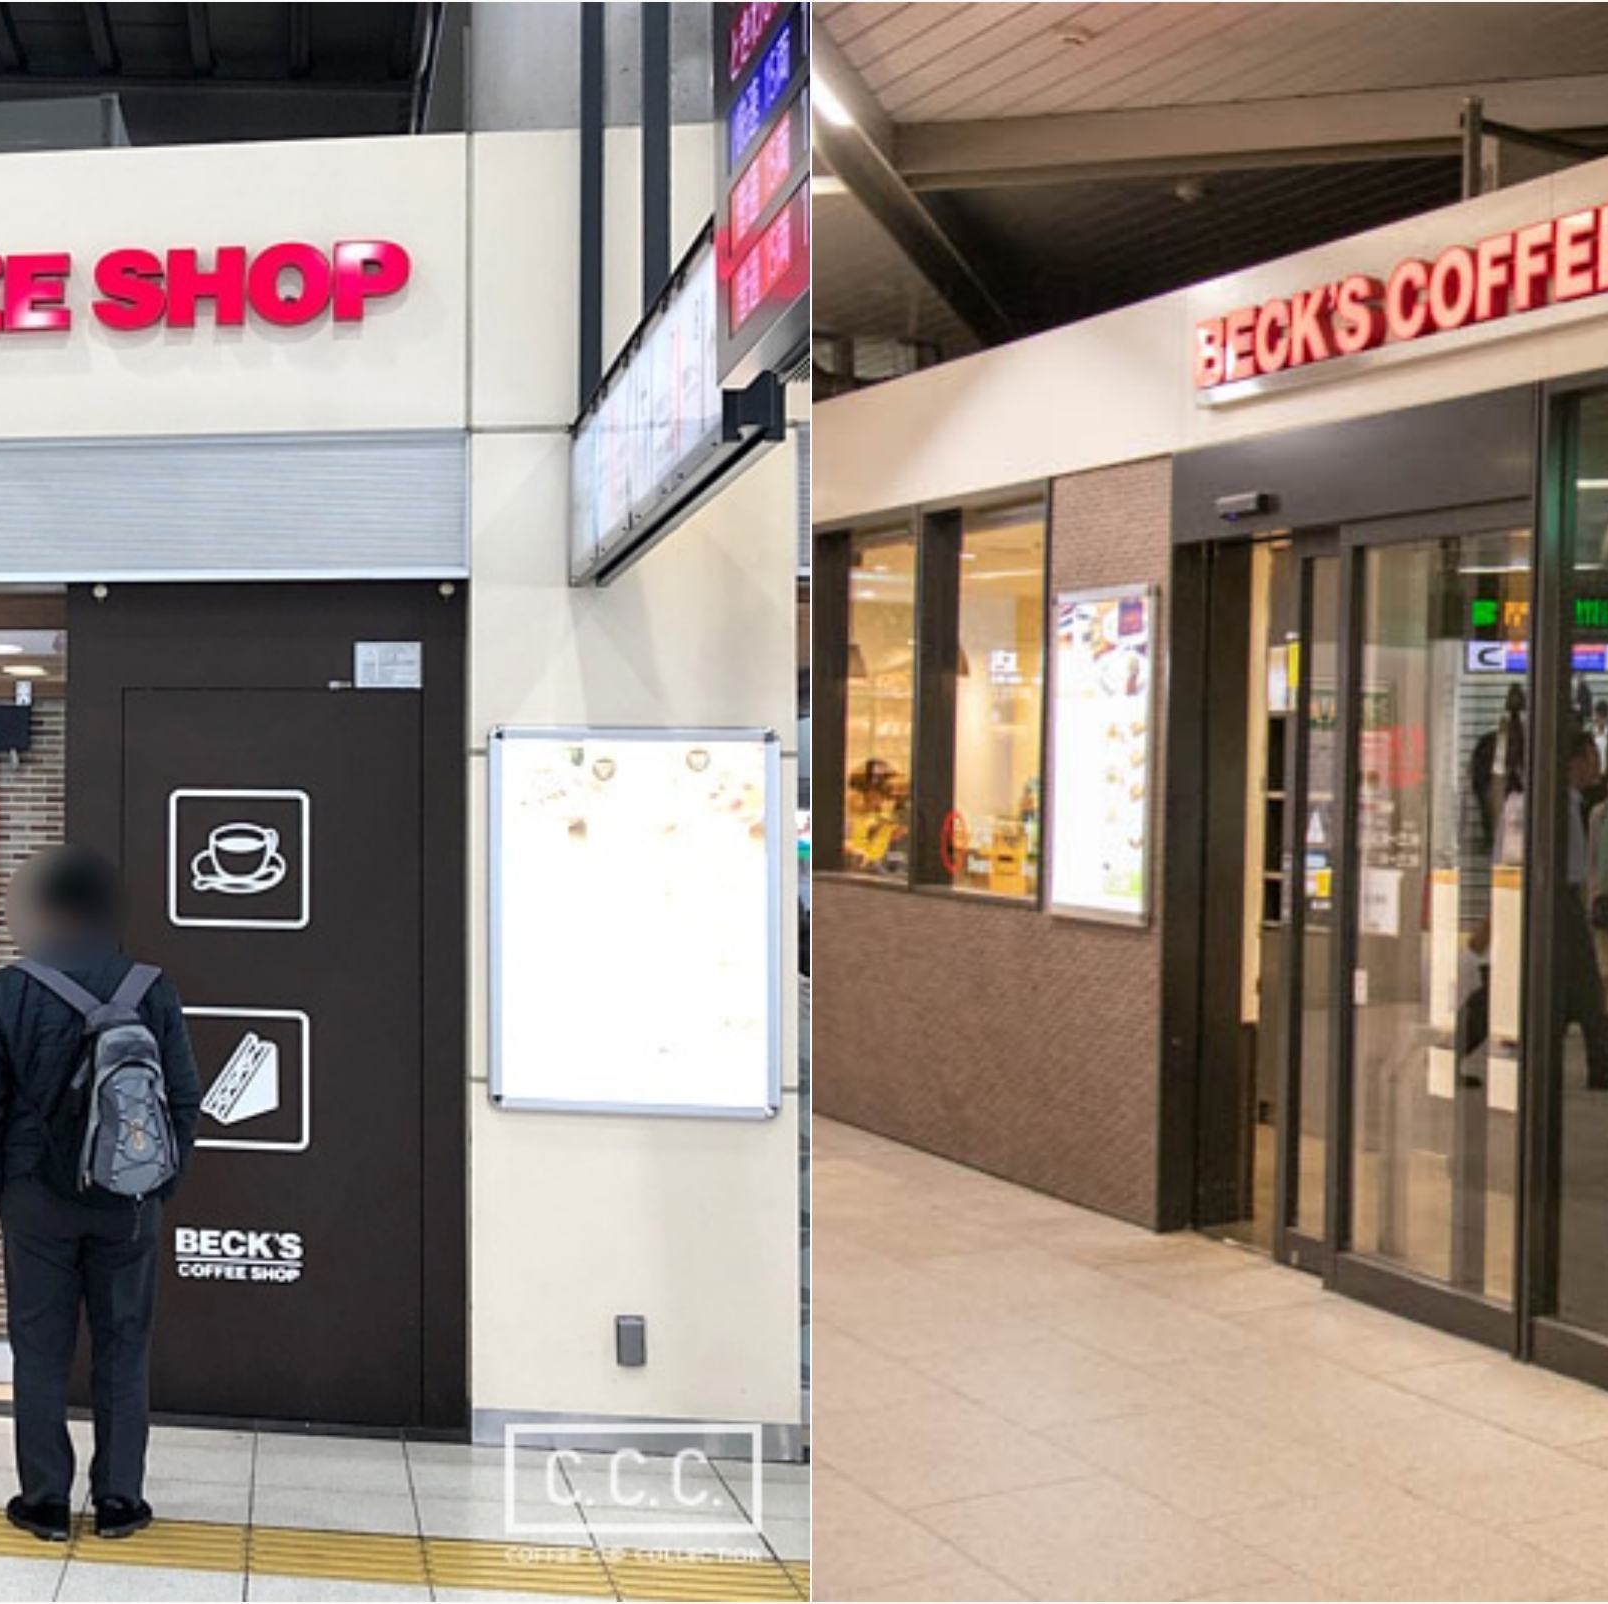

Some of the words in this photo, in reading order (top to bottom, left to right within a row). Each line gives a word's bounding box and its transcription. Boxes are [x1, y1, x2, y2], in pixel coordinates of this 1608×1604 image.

[91, 239, 411, 330] SHOP
[1196, 272, 1385, 389] BECK'S
[175, 1226, 304, 1260] BECK'S
[178, 1262, 247, 1280] COFFEE
[250, 1265, 301, 1284] SHOP
